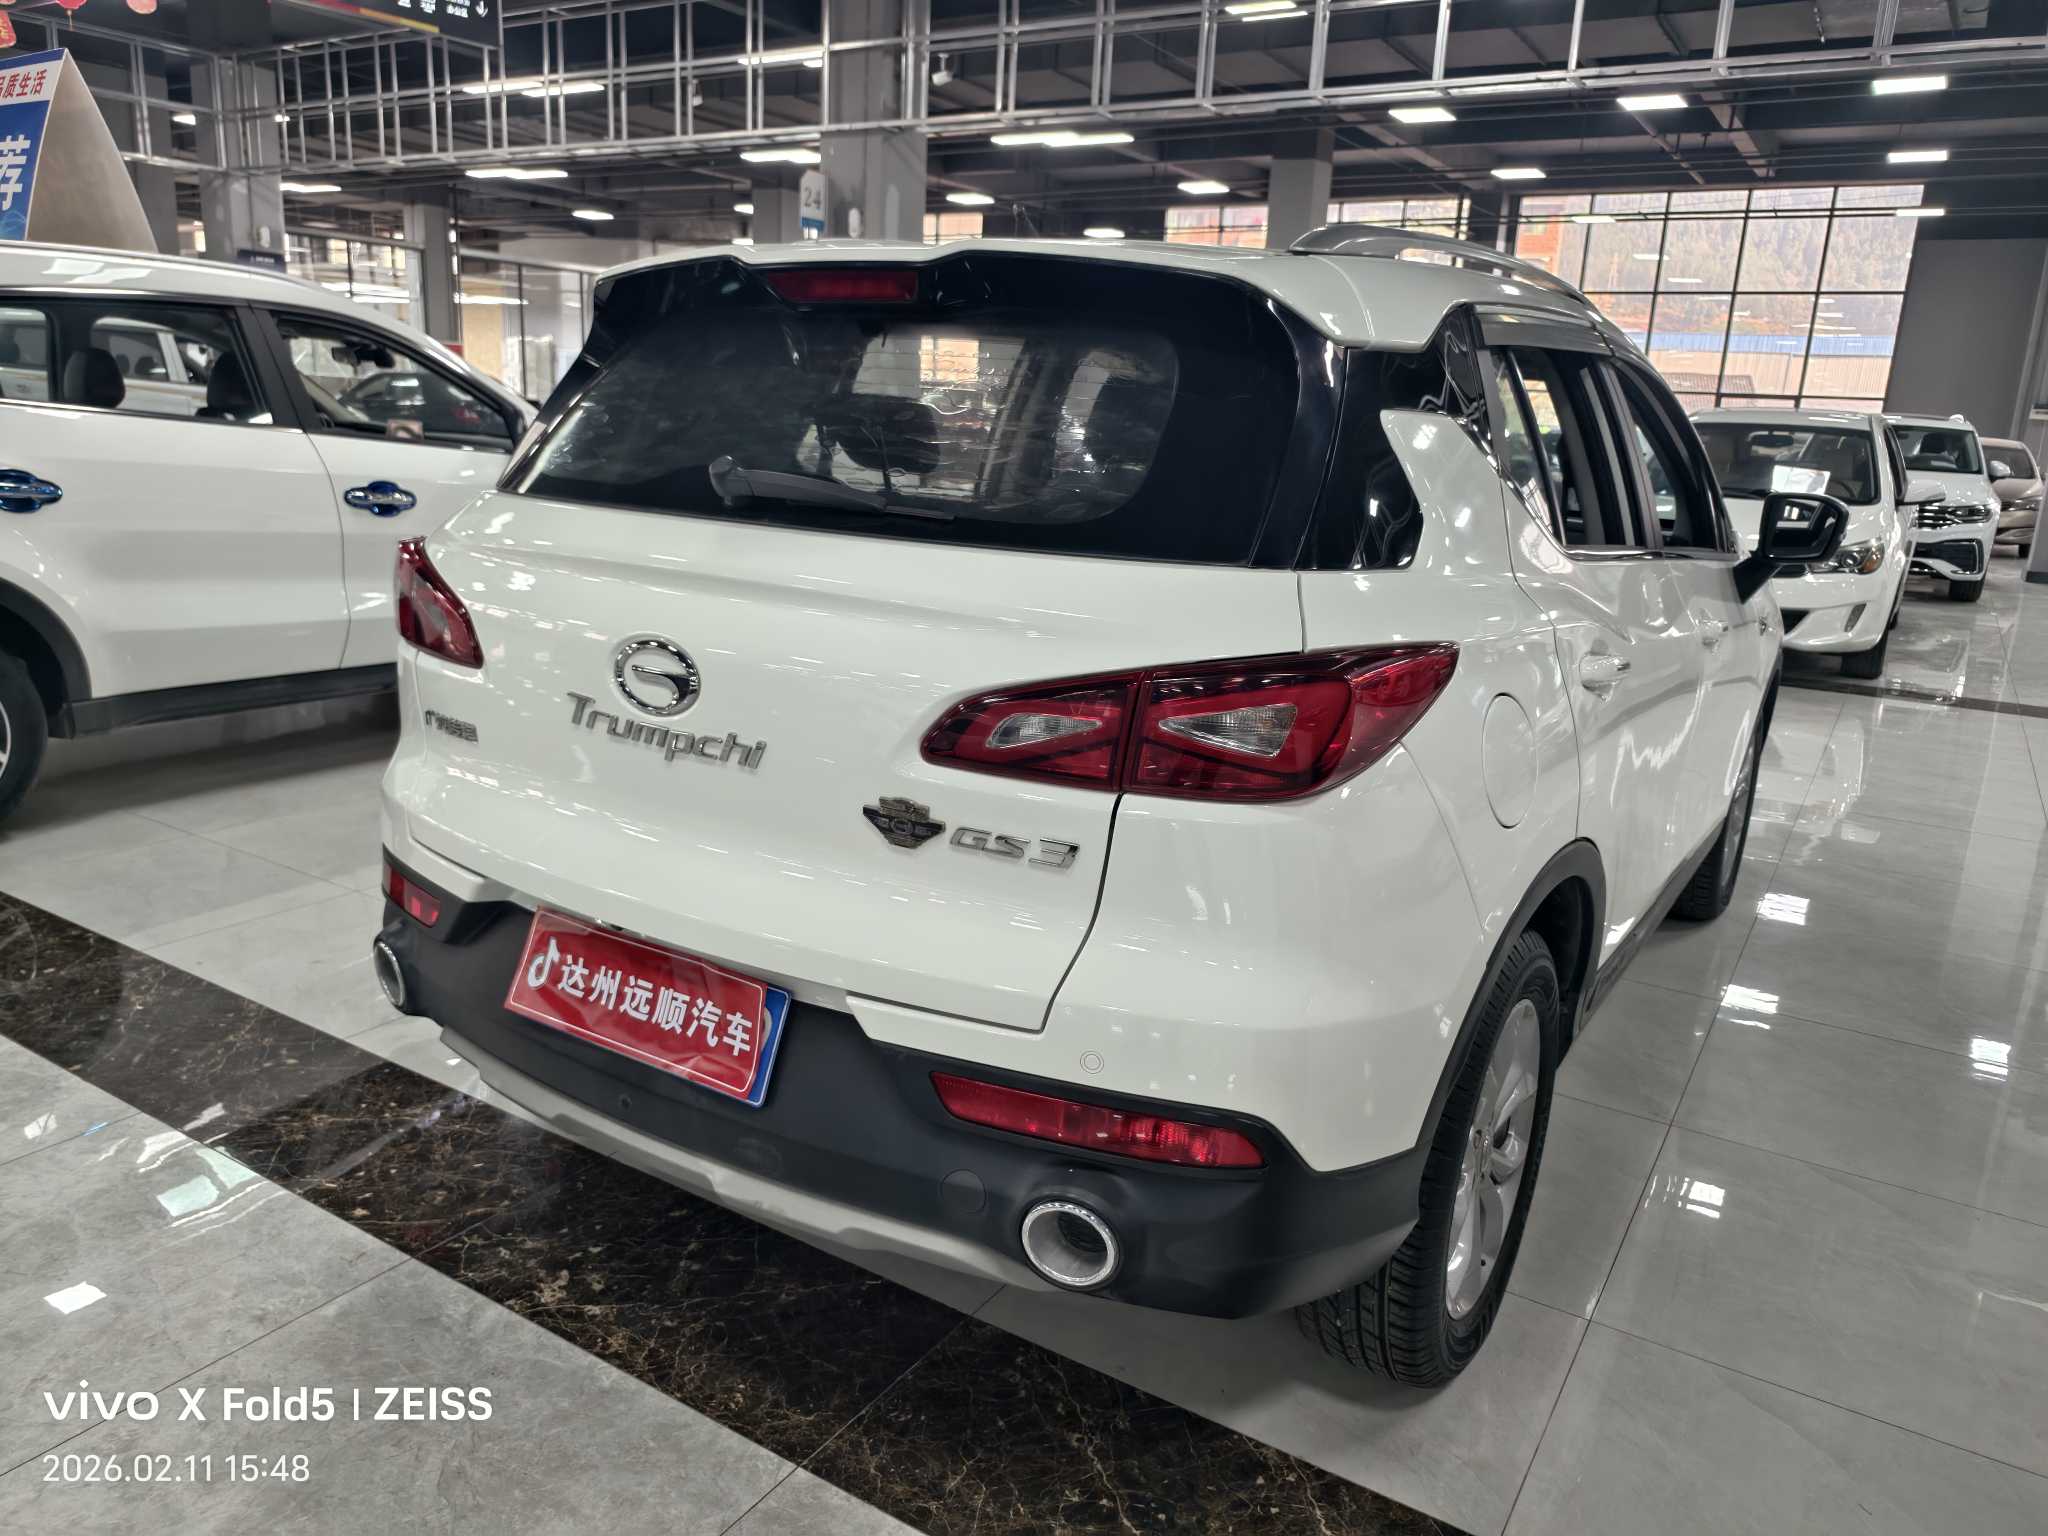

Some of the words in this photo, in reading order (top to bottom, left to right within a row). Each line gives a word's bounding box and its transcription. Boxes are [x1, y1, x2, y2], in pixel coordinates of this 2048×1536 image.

[804, 186, 822, 209] 24
[567, 691, 768, 770] Trumpchi
[950, 826, 1080, 868] GS3
[556, 954, 754, 1057] 达州远顺汽车
